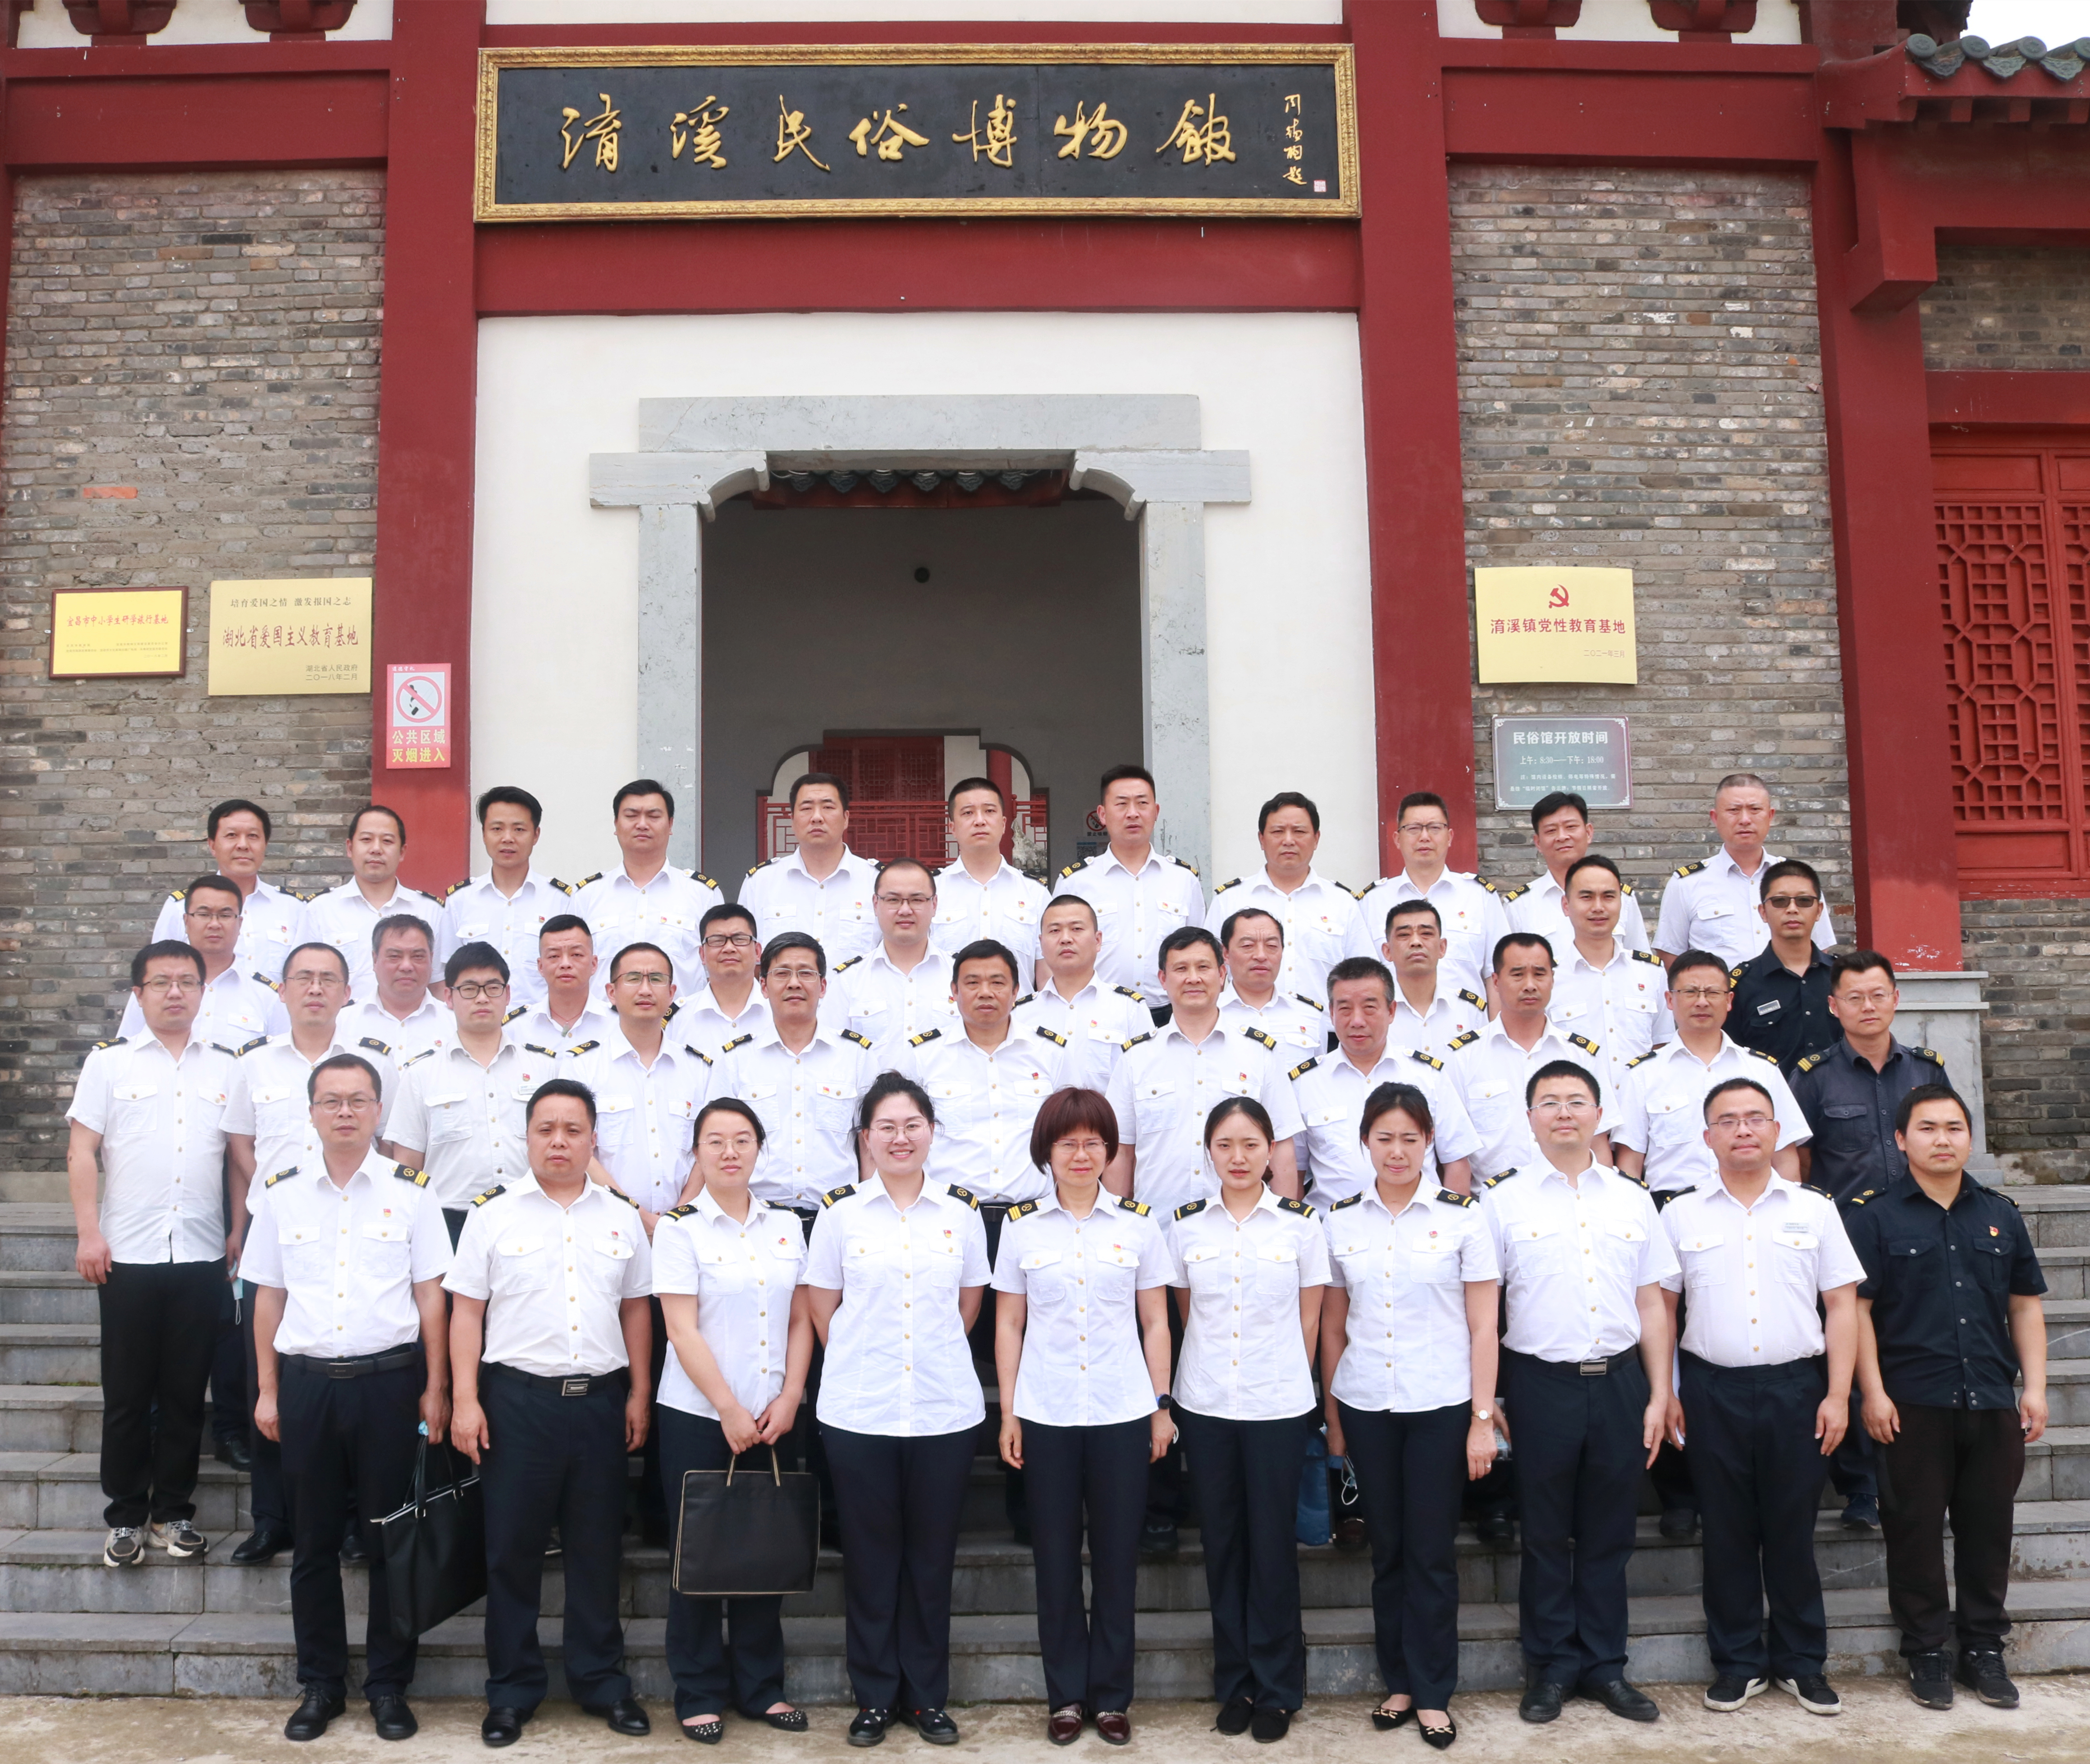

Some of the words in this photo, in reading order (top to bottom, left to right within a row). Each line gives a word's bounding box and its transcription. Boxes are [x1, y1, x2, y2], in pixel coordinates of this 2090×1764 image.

[230, 598, 288, 607] 培育爱国之情
[294, 596, 351, 606] 激发报国之志
[67, 614, 169, 627] 宜昌市中小学生研学旅行基地
[1490, 618, 1626, 634] 淯溪镇党性教育基地
[223, 623, 358, 649] 湖北省爱国主义教育基地
[306, 664, 358, 672] 湖北省人民政府
[392, 729, 445, 744] 公共区域
[1513, 731, 1608, 745] 民俗馆开放时间
[392, 747, 445, 762] 灭烟进入
